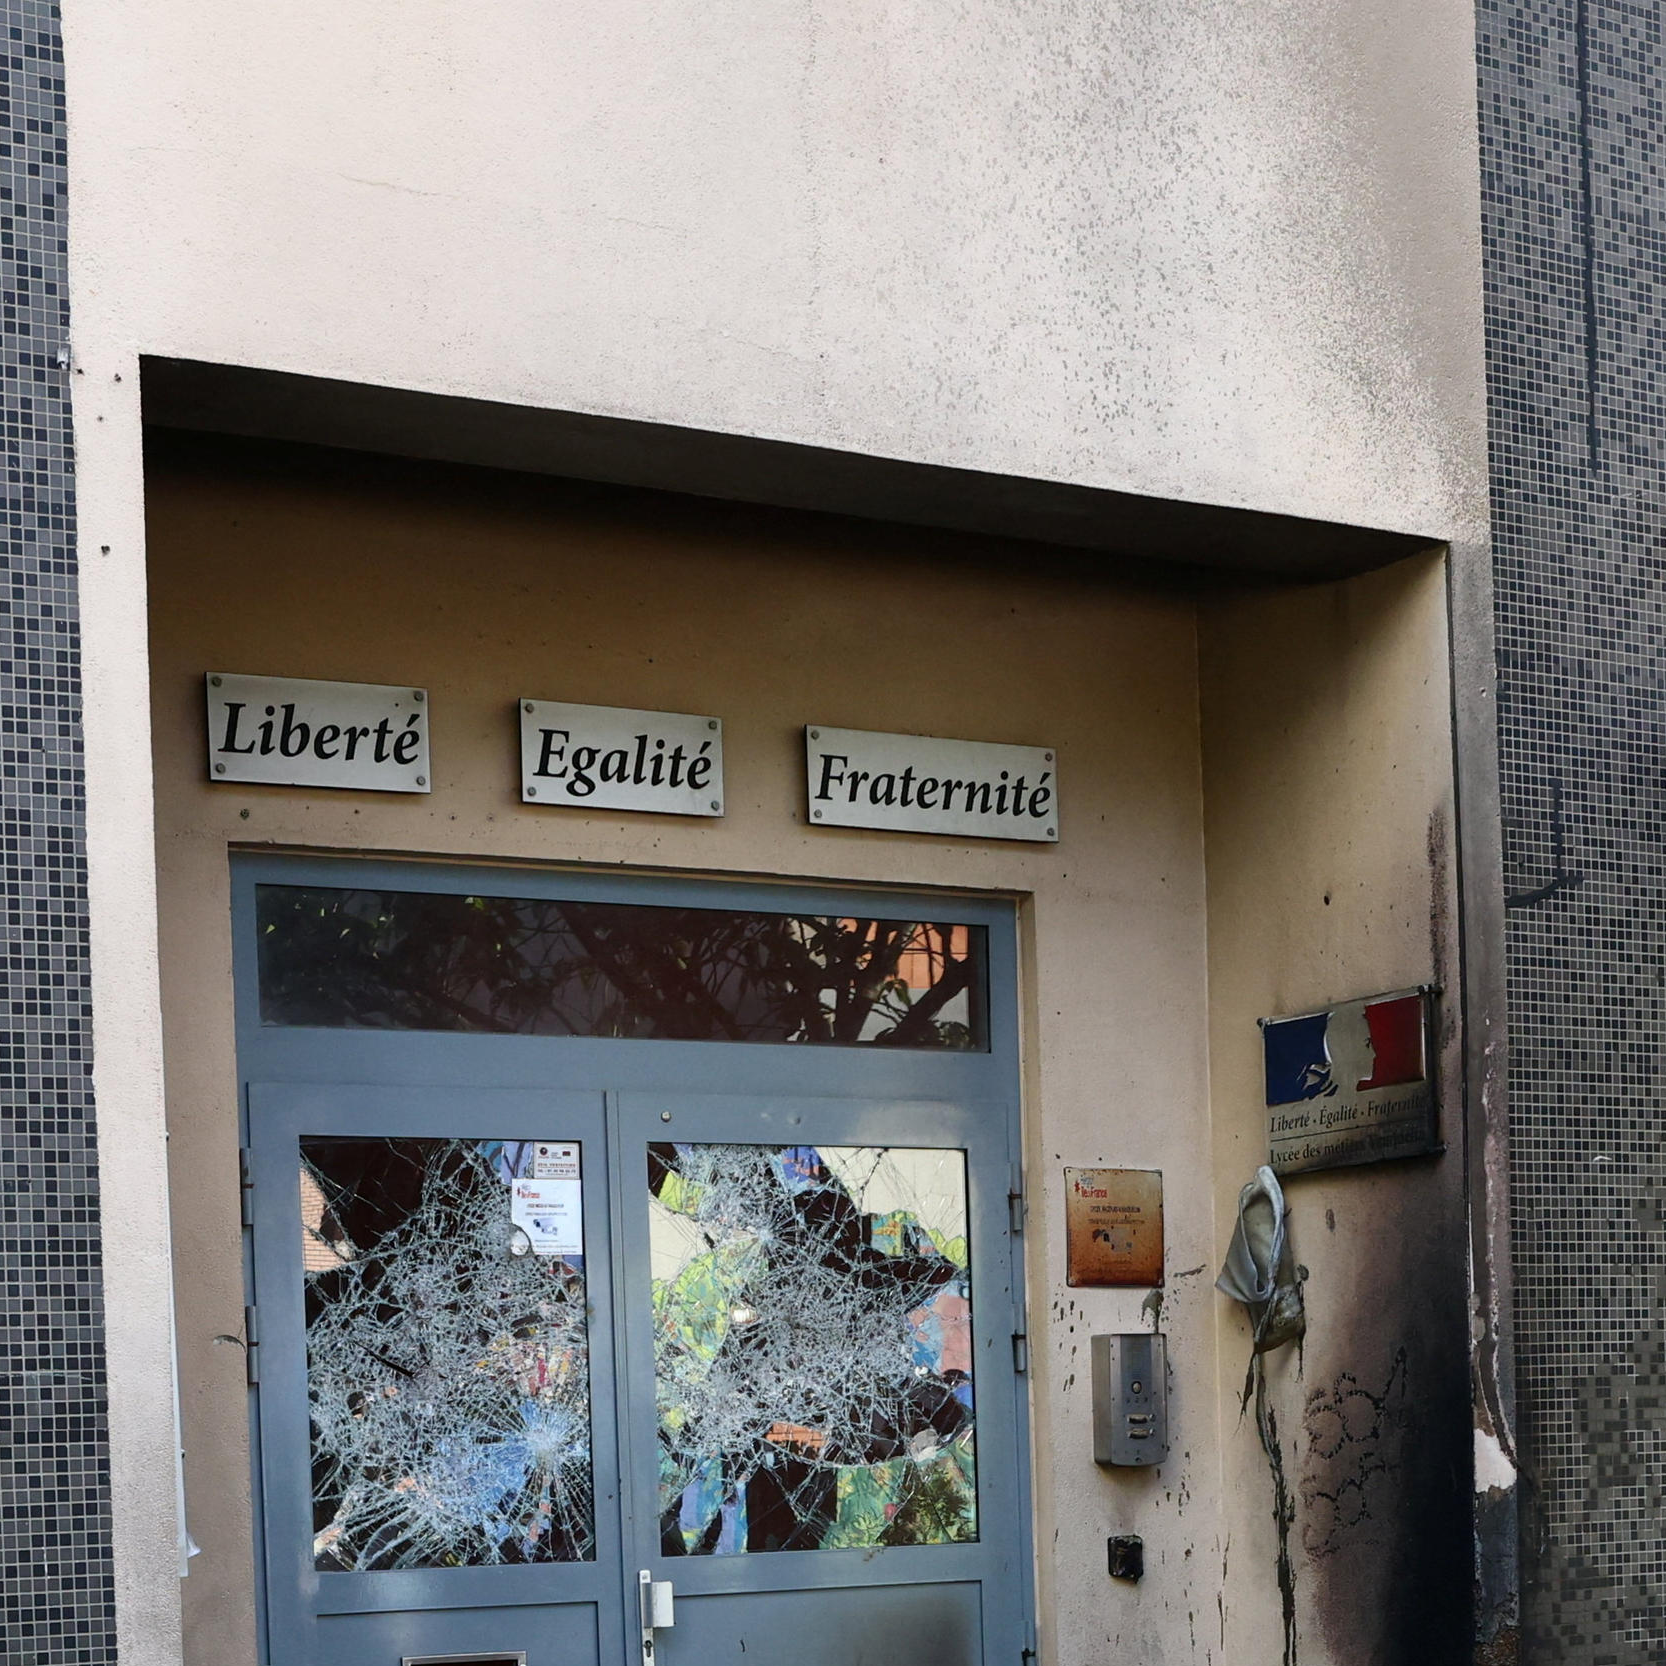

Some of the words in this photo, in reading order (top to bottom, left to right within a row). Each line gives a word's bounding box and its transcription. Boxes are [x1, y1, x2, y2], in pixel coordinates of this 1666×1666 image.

[217, 701, 422, 765] Liberté
[532, 727, 713, 797] Egalité
[814, 753, 1051, 818] Fraternité
[1270, 1111, 1310, 1133] Liberté
[1319, 1104, 1358, 1129] Égalité
[1270, 1147, 1300, 1168] Lycée
[1302, 1143, 1321, 1159] des
